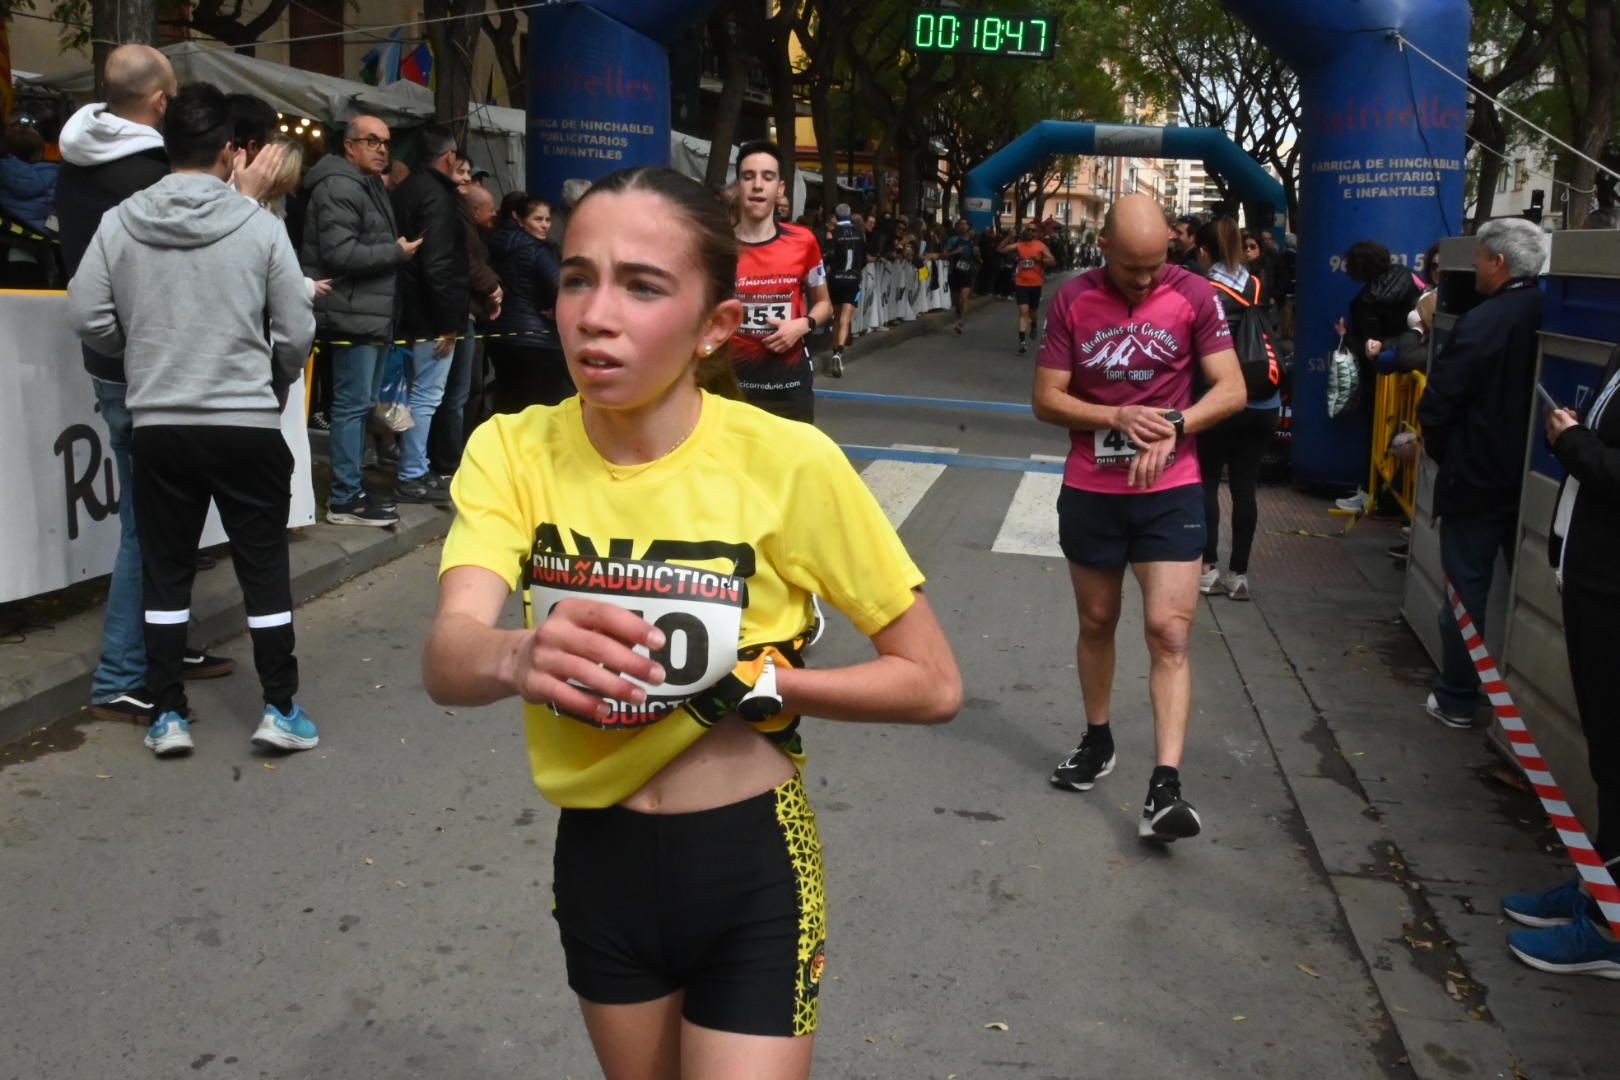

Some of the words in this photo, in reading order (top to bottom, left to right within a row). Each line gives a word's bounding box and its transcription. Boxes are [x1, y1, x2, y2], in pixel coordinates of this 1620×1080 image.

[916, 14, 1047, 52] 00:18:47
[561, 120, 577, 129] DE
[580, 120, 655, 135] HINCHABLES
[540, 131, 629, 148] PUBLICITARIOS
[552, 146, 623, 160] INFANTILES
[1366, 158, 1384, 169] DE
[1338, 171, 1441, 184] PUBLICITARIOS
[1344, 188, 1352, 199] E
[1356, 186, 1436, 198] INFANTILES
[1128, 369, 1155, 380] GROUP
[532, 553, 570, 581] RUN
[588, 560, 740, 602] ADDICTION
